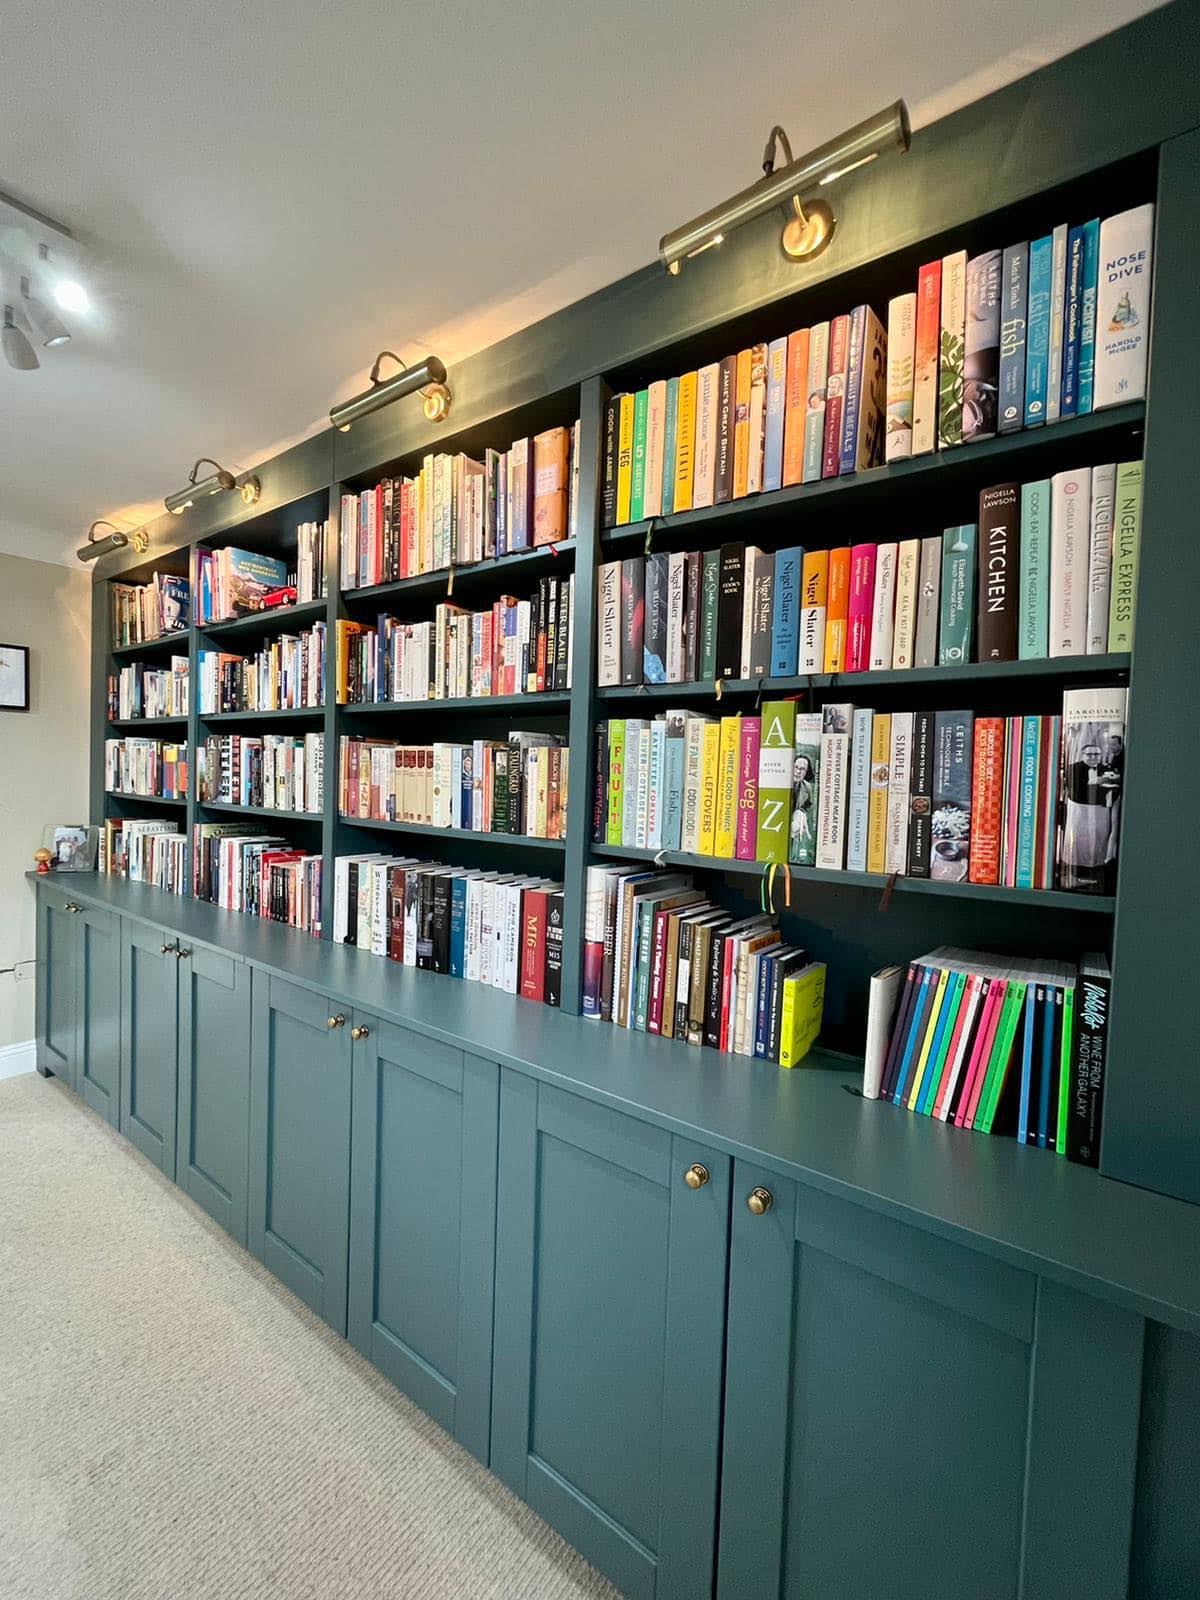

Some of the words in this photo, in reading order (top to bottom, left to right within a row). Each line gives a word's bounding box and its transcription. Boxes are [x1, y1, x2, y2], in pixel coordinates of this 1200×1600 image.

[1071, 239, 1080, 253] The
[1106, 250, 1146, 272] NOSE
[1010, 256, 1021, 283] Mitch
[1108, 264, 1144, 283] DIVE
[988, 266, 997, 307] LEITHS
[1009, 284, 1019, 310] Tonks
[1067, 304, 1078, 342] Cookbook
[1082, 287, 1095, 346] ROCKFISH
[1001, 317, 1025, 359] fish
[1105, 336, 1141, 351] HAROLD
[832, 344, 842, 373] OLIVER
[1066, 345, 1074, 372] MITCHELL
[702, 373, 712, 405] jamie
[722, 369, 730, 405] JAMIE'S
[1065, 374, 1073, 393] TONKS
[607, 408, 615, 434] COOK
[701, 413, 709, 440] home
[720, 406, 728, 435] GREAT
[843, 415, 854, 452] MEALS
[619, 448, 630, 468] VEG
[636, 444, 643, 458] 5
[679, 445, 689, 481] ITALY
[719, 438, 728, 475] BRITAIN
[983, 496, 1016, 509] LAWSON
[984, 489, 1015, 500] NIGELLA
[1065, 498, 1075, 530] NIGELLA
[1119, 498, 1136, 558] NIGELLA
[881, 553, 892, 570] Nigel
[1064, 531, 1074, 567] LAWSON
[669, 564, 682, 590] Nigel
[704, 563, 717, 582] Nigel
[780, 560, 794, 590] Nigel
[881, 571, 890, 589] Slater
[957, 558, 966, 590] Elizabeth
[987, 526, 1007, 613] KITCHEN
[1063, 571, 1073, 597] SIMPLY
[601, 568, 615, 605] Nigel
[759, 575, 771, 601] Nigel
[807, 572, 820, 605] Nigel
[957, 591, 965, 611] David
[1028, 577, 1039, 610] NIGELLA
[1116, 563, 1134, 622] EXPRESS
[559, 586, 569, 624] AFTER
[652, 589, 660, 617] SLATER
[671, 591, 681, 619] Slater
[760, 603, 770, 633] Slater
[781, 592, 793, 624] Slater
[901, 595, 909, 612] REAL
[948, 604, 957, 626] Cooking
[1063, 598, 1072, 630] NIGELLA
[603, 607, 615, 648] Slater
[806, 609, 817, 648] Slater
[901, 615, 909, 630] FAST
[1027, 611, 1038, 647] LAWSON
[558, 626, 567, 660] BLAIR
[900, 632, 908, 649] FOOD
[763, 716, 790, 746] A
[859, 735, 865, 743] TO
[955, 725, 965, 764] LEITHS
[986, 729, 994, 757] HAROLD
[1027, 721, 1036, 745] McGEE
[639, 738, 648, 765] RIVER
[689, 746, 699, 778] FAMILY
[727, 749, 735, 775] THREE
[894, 735, 906, 780] SIMPLE
[943, 726, 952, 768] TECHNIQUES
[1026, 746, 1033, 756] on
[509, 750, 519, 794] STALINGRAD
[650, 751, 658, 787] BETTER
[744, 753, 752, 778] Cottage
[1025, 756, 1034, 777] FOOD
[639, 772, 648, 811] COTTAGE
[668, 790, 680, 813] Fish
[725, 776, 734, 801] GOOD
[739, 778, 757, 810] veg
[822, 759, 833, 847] FEARNLEY-WHITTINGSTALL
[833, 773, 841, 804] COTTAGE
[1023, 784, 1032, 817] COOKING
[686, 789, 697, 836] COOKBOOK
[703, 776, 713, 833] LEFTOVERS
[724, 802, 732, 833] THINGS
[761, 798, 784, 833] Z
[637, 821, 646, 845] YEAR
[831, 825, 839, 844] BOOK
[1022, 818, 1031, 847] HAROLD
[527, 914, 538, 948] MI6
[603, 925, 614, 956] BEER
[711, 939, 721, 970] Exploring
[1078, 1033, 1091, 1077] ANOTHER
[1090, 1036, 1103, 1059] WINE
[1089, 1061, 1102, 1089] FROM
[1075, 1078, 1088, 1119] GALAXY
